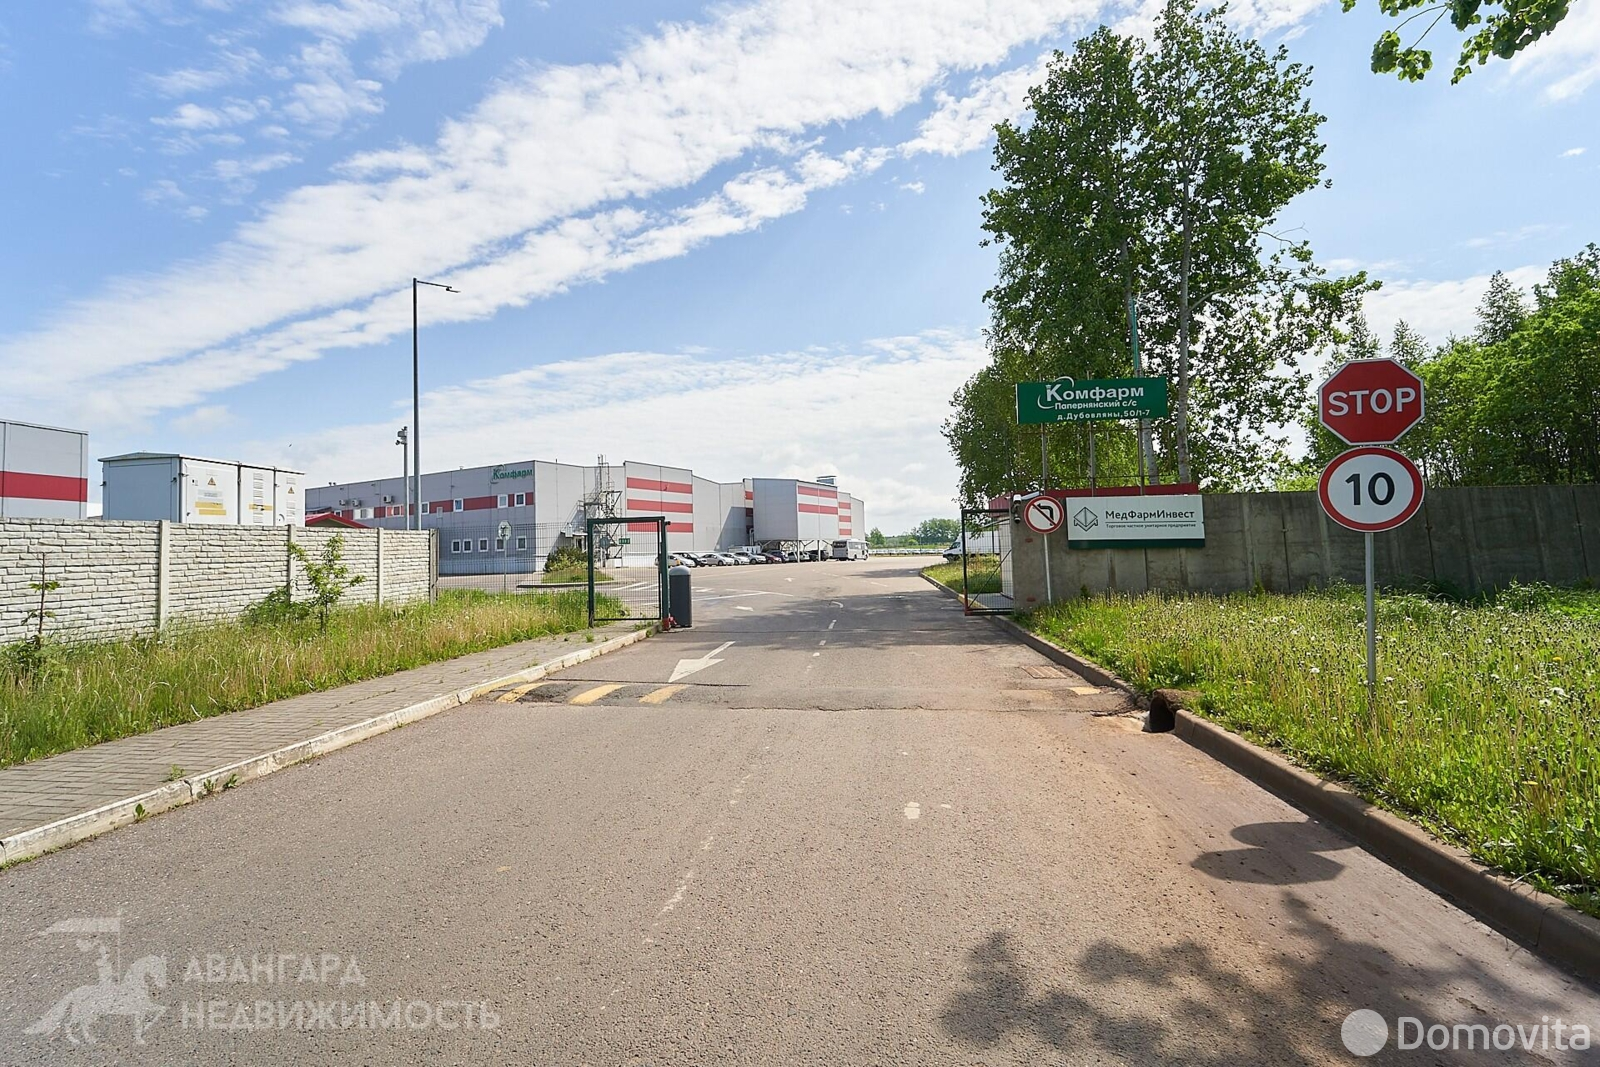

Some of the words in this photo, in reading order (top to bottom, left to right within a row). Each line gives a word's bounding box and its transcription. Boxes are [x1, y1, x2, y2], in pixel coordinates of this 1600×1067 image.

[1046, 383, 1144, 402] Комфарм
[1055, 400, 1121, 410] Папернянский
[1122, 399, 1138, 407] с/с
[1328, 387, 1416, 416] STOP
[493, 468, 533, 480] Комфарм
[1345, 472, 1395, 506] 10
[1105, 509, 1195, 521] МедФармИнвест
